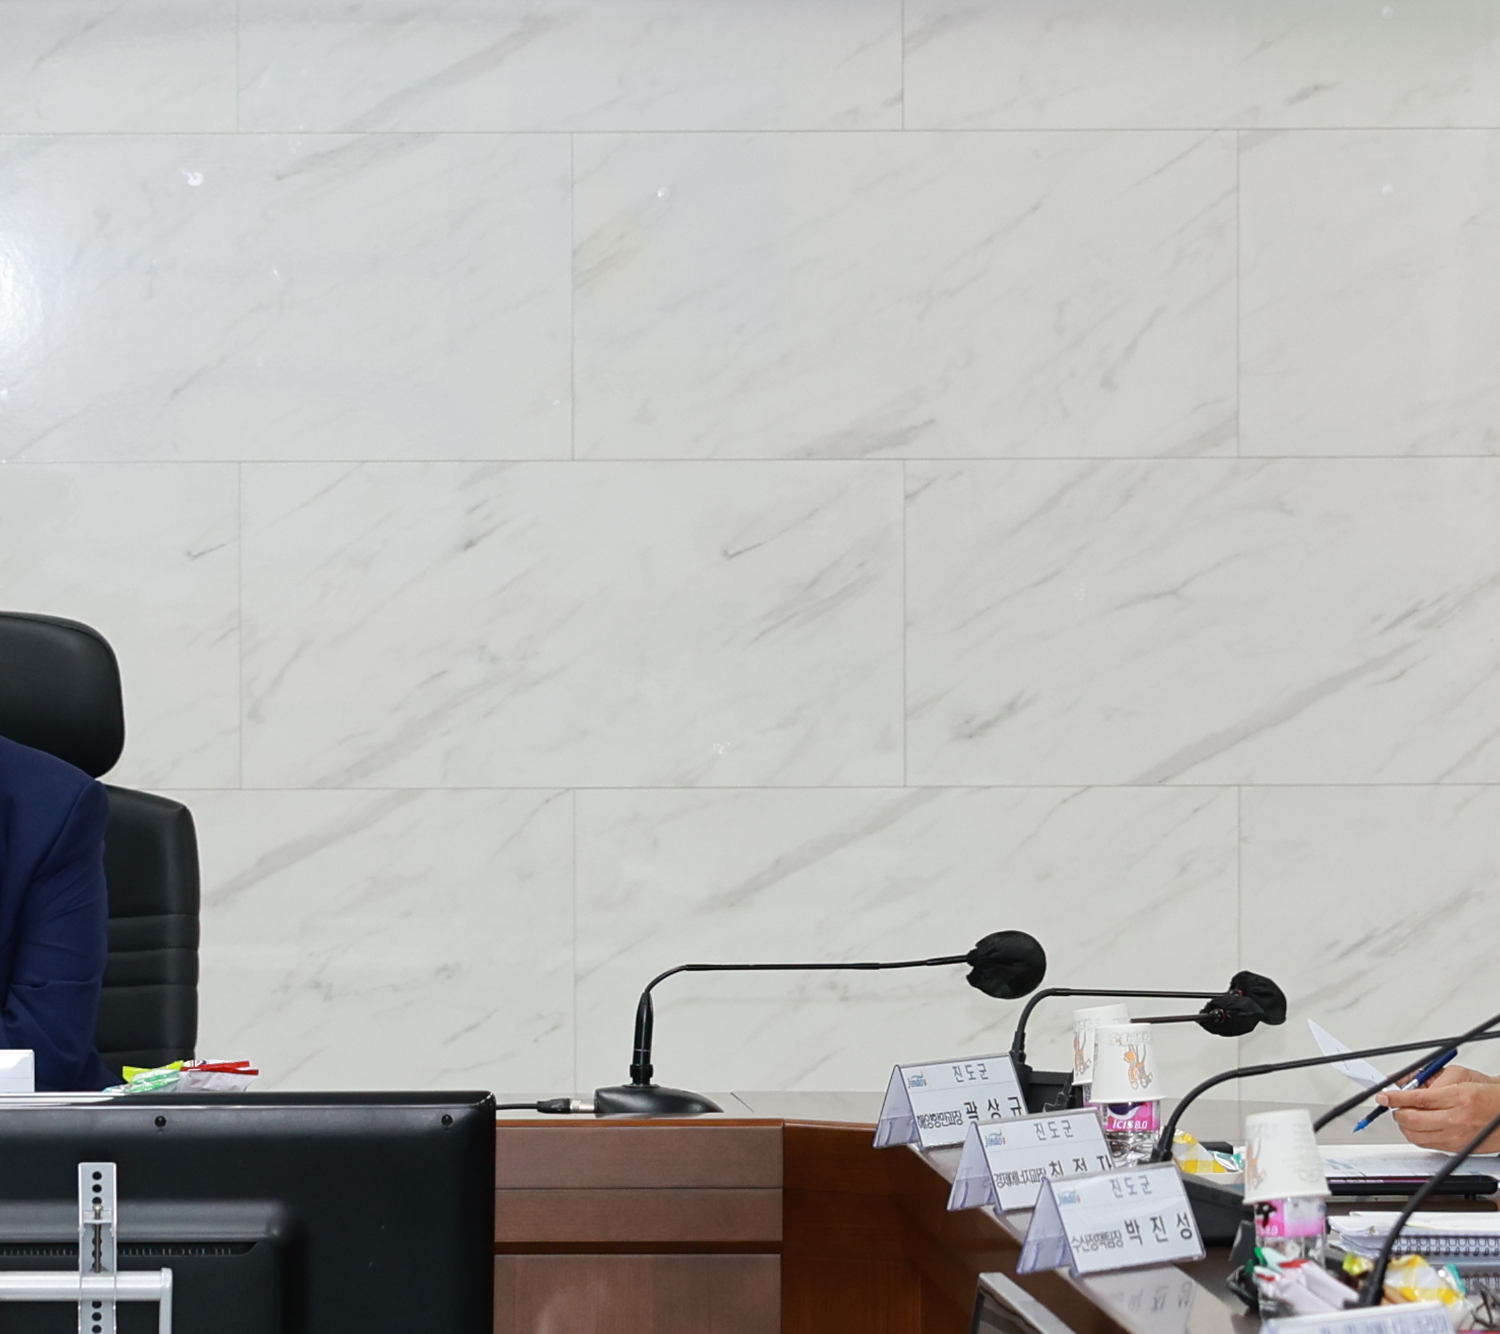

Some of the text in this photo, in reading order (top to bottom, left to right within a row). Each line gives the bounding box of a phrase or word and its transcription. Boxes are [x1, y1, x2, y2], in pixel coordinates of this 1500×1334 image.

[951, 1062, 990, 1083] 진도군
[1033, 1119, 1074, 1141] 진도군
[1109, 1174, 1153, 1199] 진도군
